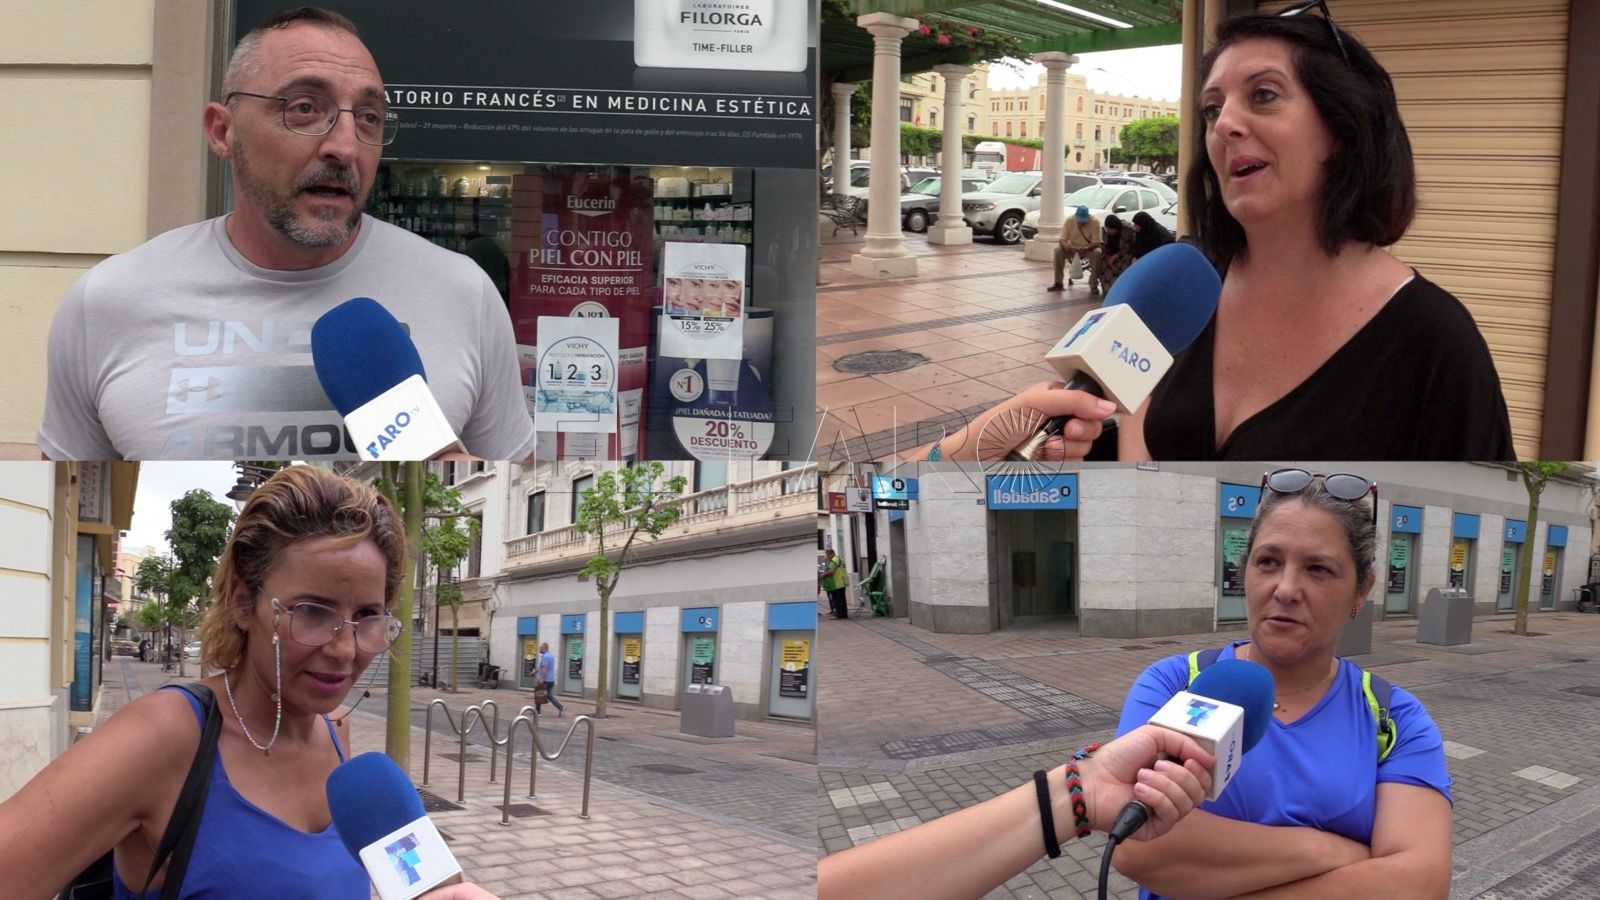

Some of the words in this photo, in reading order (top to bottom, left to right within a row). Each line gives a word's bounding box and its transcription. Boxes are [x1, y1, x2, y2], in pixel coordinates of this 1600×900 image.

[680, 11, 762, 26] FILORGA
[692, 42, 753, 54] TIME-FILLER
[572, 95, 598, 109] EN
[608, 96, 707, 113] MEDICINA
[716, 97, 811, 116] ESTÉTICA
[566, 195, 616, 210] Eucerin
[546, 230, 632, 248] CONTIGO
[529, 249, 565, 265] PIEL
[567, 250, 612, 266] CON
[616, 251, 643, 266] PIEL
[541, 274, 589, 286] EFICACIA
[590, 275, 634, 286] SUPERIOR
[530, 285, 556, 295] PARA
[558, 286, 587, 296] CADA
[589, 286, 612, 296] TIPO
[613, 287, 625, 296] DE
[626, 287, 641, 296] PIEL
[692, 407, 725, 417] DAÑADA
[705, 420, 744, 440] 20%
[690, 436, 758, 450] DESCUENTO
